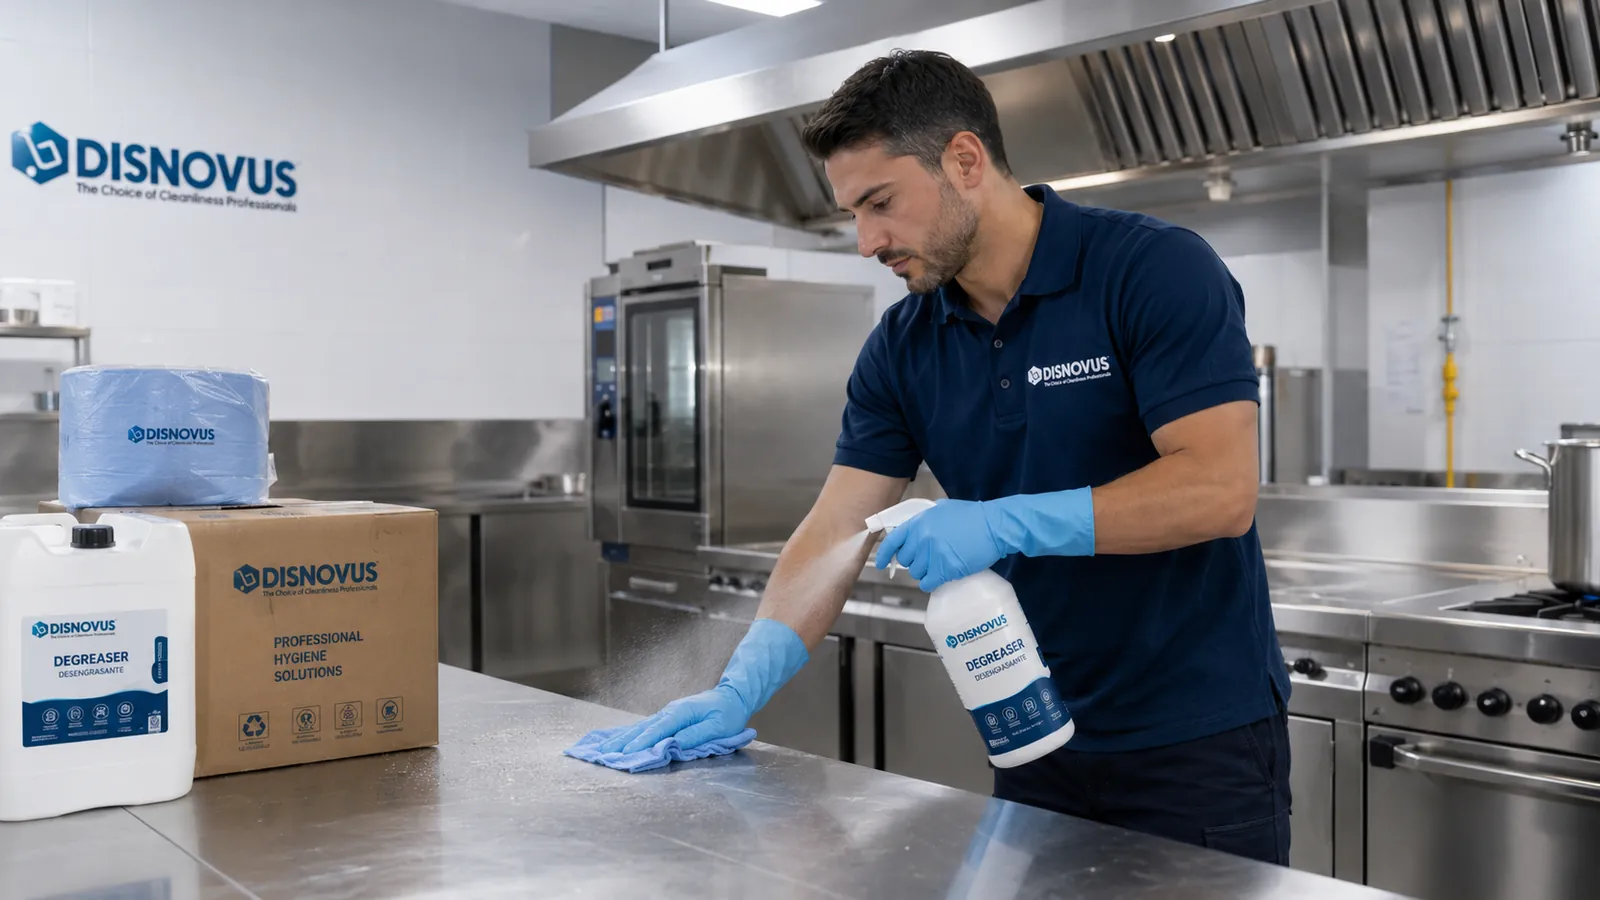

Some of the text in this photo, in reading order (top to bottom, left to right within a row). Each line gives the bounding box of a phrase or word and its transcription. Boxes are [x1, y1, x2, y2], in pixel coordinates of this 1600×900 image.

[76, 138, 297, 197] DISNOVUS
[76, 182, 297, 213] The Choice of Cleanliness Professionals
[1043, 356, 1110, 381] DISNOVUS
[146, 428, 215, 441] DISNOVUS
[262, 562, 378, 589] DISNOVUS
[50, 620, 116, 635] DISNOVUS
[957, 614, 1008, 643] DISNOVUS
[274, 630, 364, 648] PROFESSIONAL
[54, 651, 129, 667] DEGREASER
[274, 650, 328, 665] HYGIENE
[965, 638, 1025, 672] DEGREASER
[58, 666, 124, 679] DESENGRASANTE
[274, 665, 343, 683] SOLUTIONS
